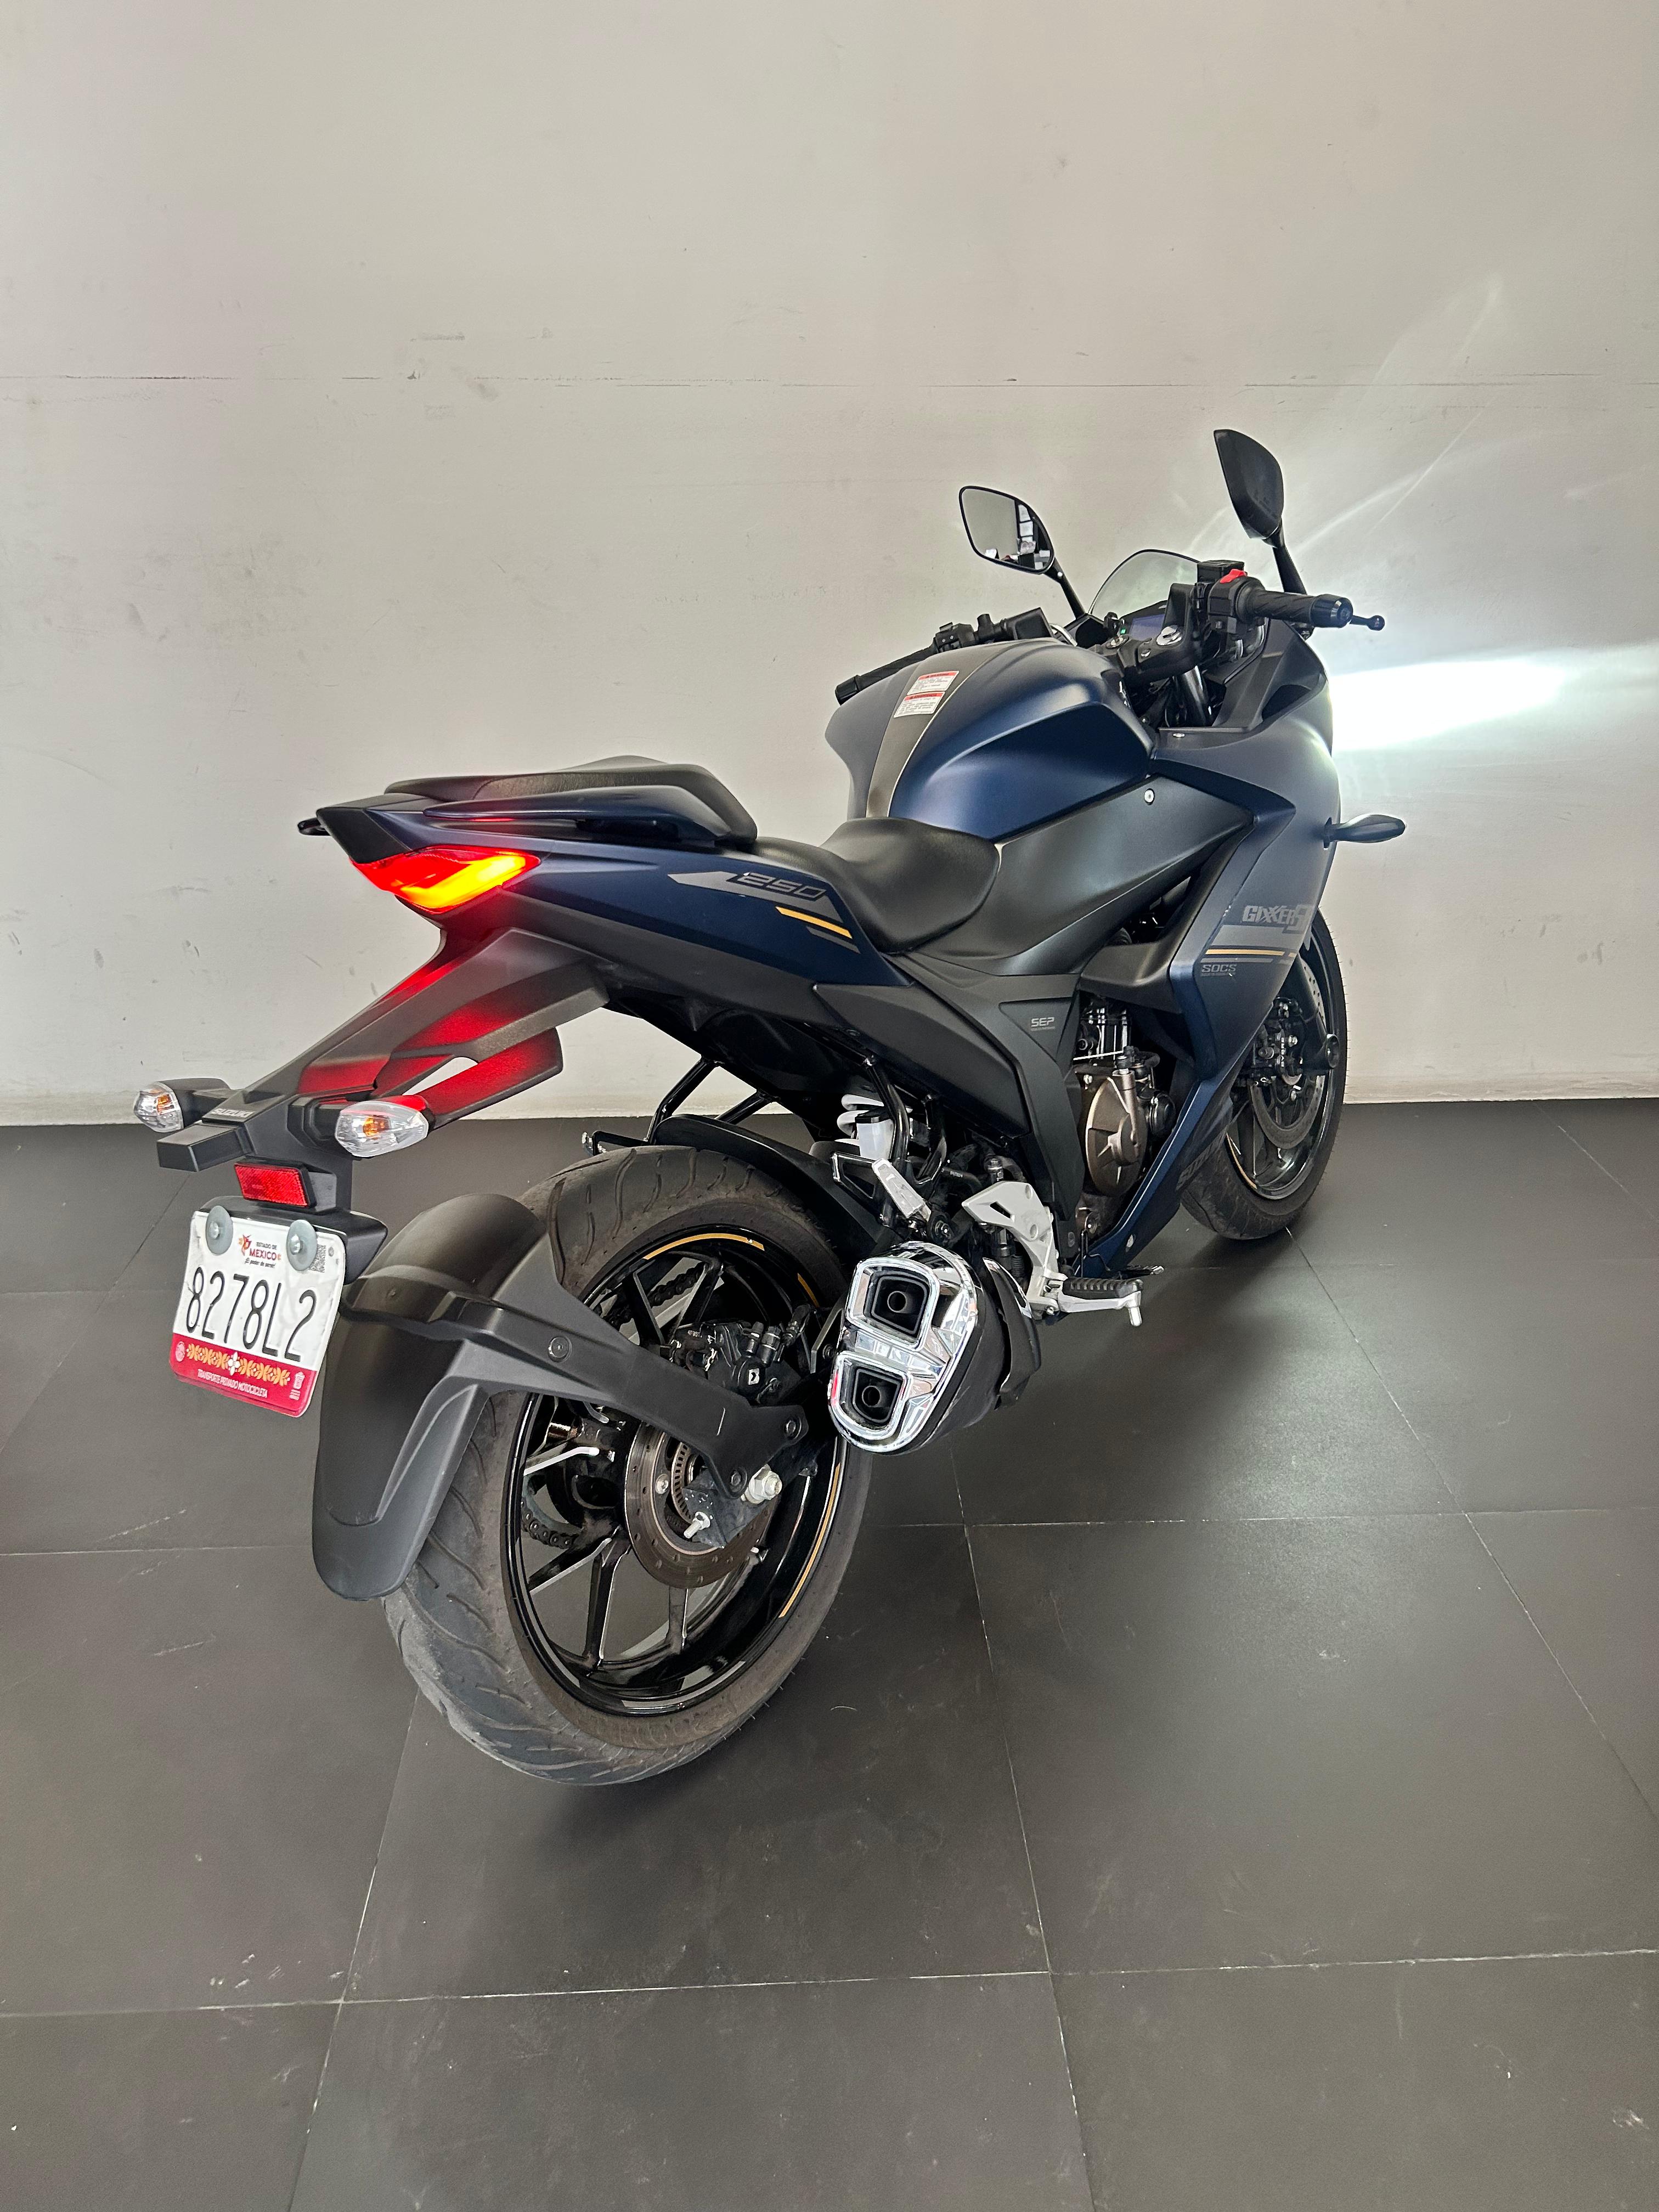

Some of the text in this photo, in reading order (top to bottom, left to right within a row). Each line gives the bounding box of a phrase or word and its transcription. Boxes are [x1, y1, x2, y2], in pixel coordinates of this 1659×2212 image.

[737, 872, 826, 899] 250
[1201, 964, 1237, 973] SOCS
[1031, 1017, 1054, 1027] SEP
[211, 1108, 255, 1118] SUZUKI
[186, 1267, 317, 1362] 8278L2
